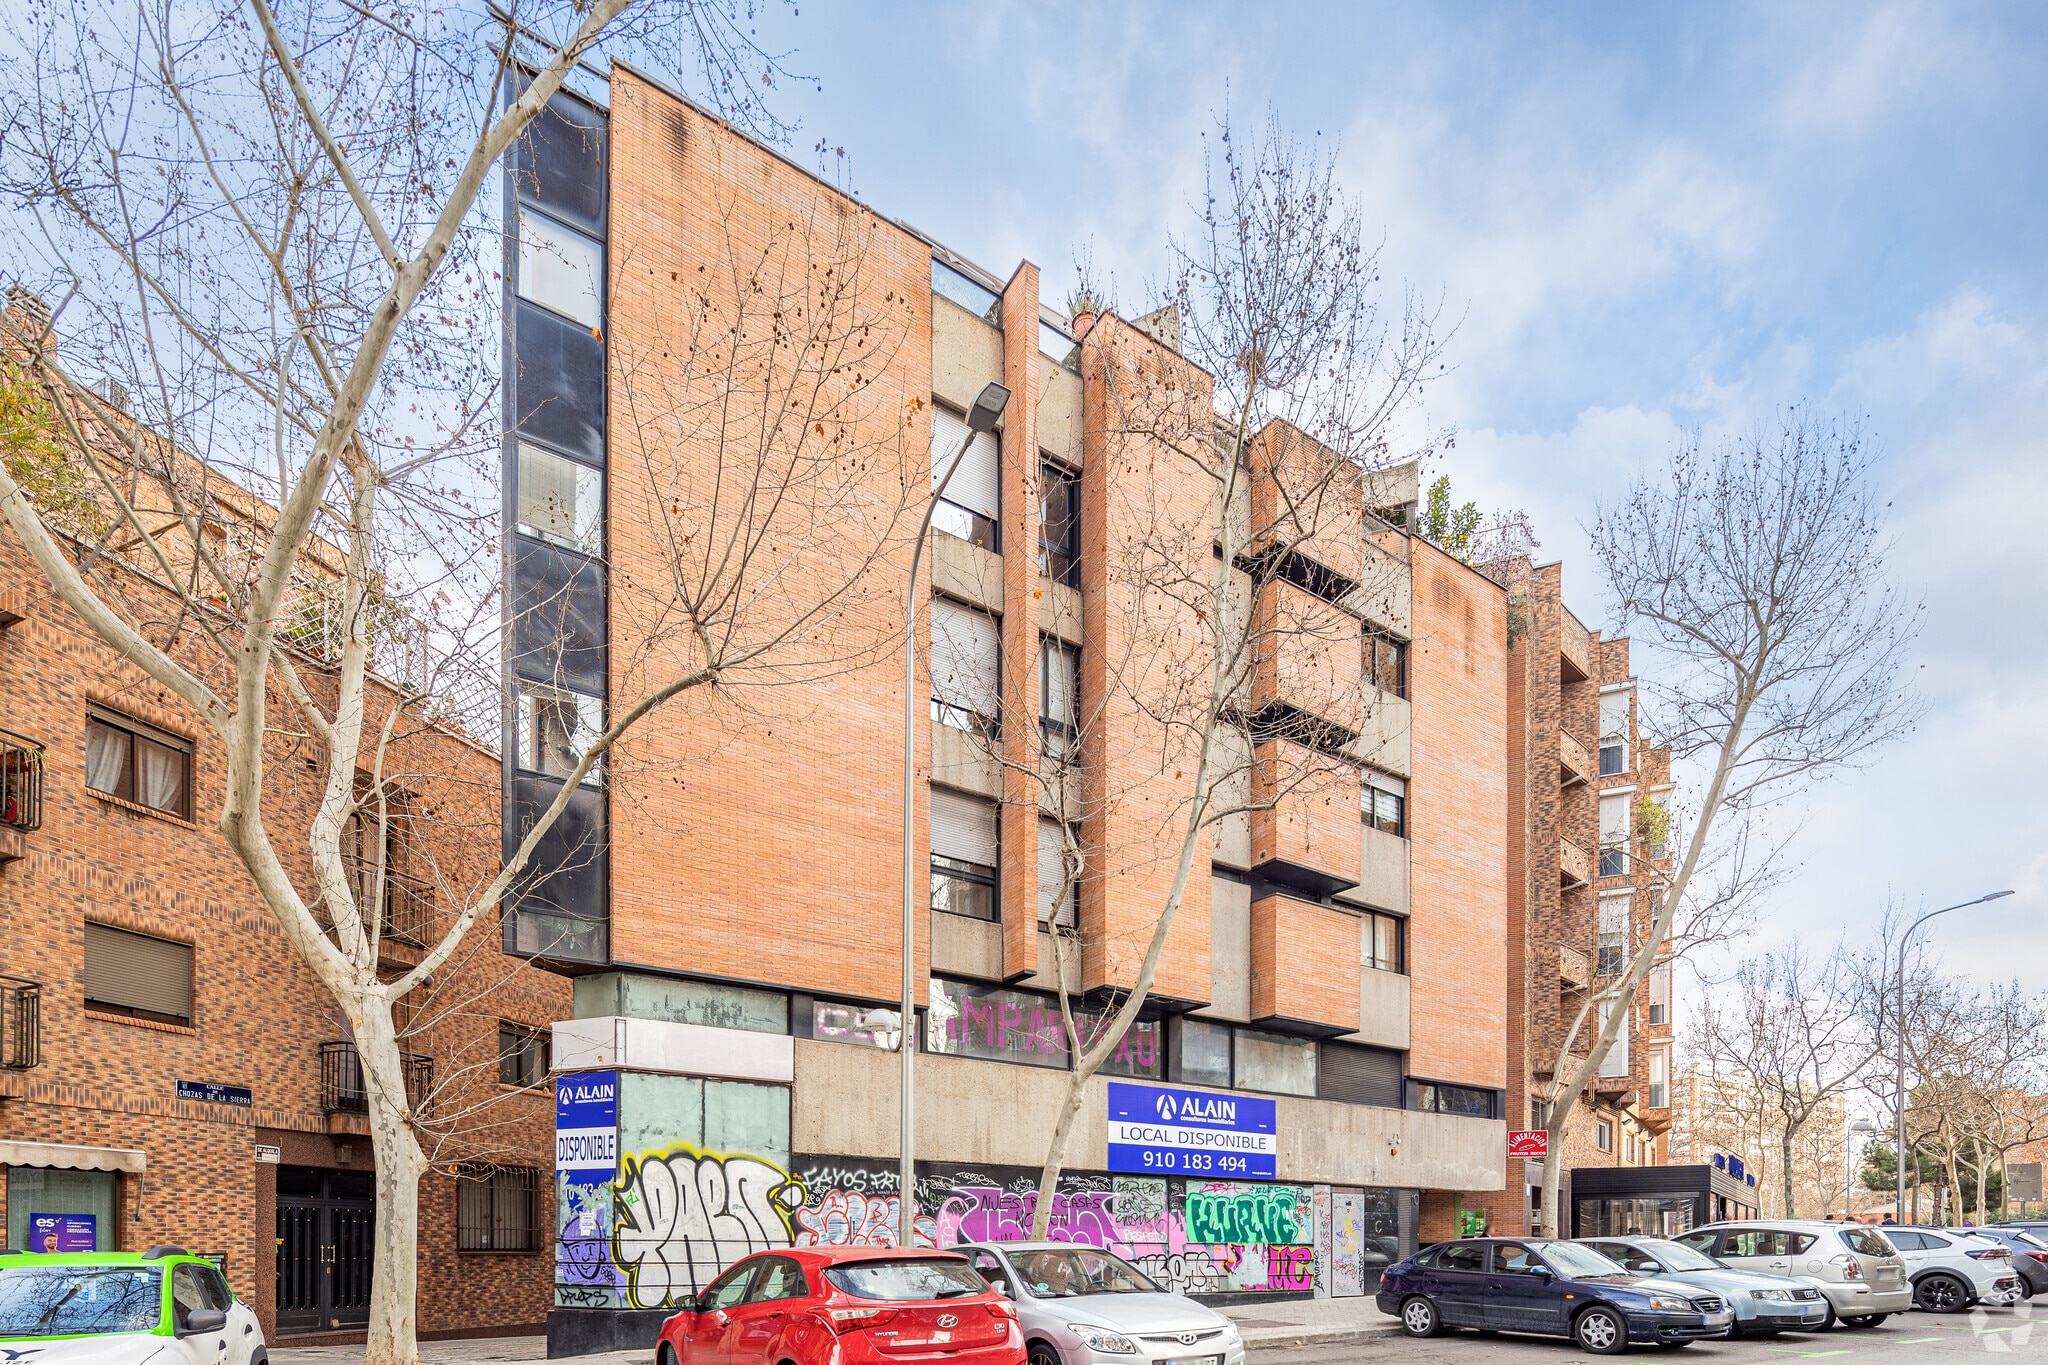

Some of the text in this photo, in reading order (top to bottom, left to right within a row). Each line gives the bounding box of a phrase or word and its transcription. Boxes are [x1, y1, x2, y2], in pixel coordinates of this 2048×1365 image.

[178, 1089, 203, 1099] CHOZAS
[230, 1096, 250, 1104] SIERRA
[575, 1084, 614, 1100] ALAIN
[1181, 1097, 1236, 1120] ALAIN
[1180, 1115, 1236, 1126] consultores inmobiliarios
[1120, 1126, 1267, 1150] LOCAL DISPONIBLE
[1509, 1132, 1548, 1148] ALIMENTACION
[559, 1135, 614, 1161] DISPONIBLE
[1143, 1151, 1247, 1172] 910 183 494
[36, 1218, 55, 1227] es
